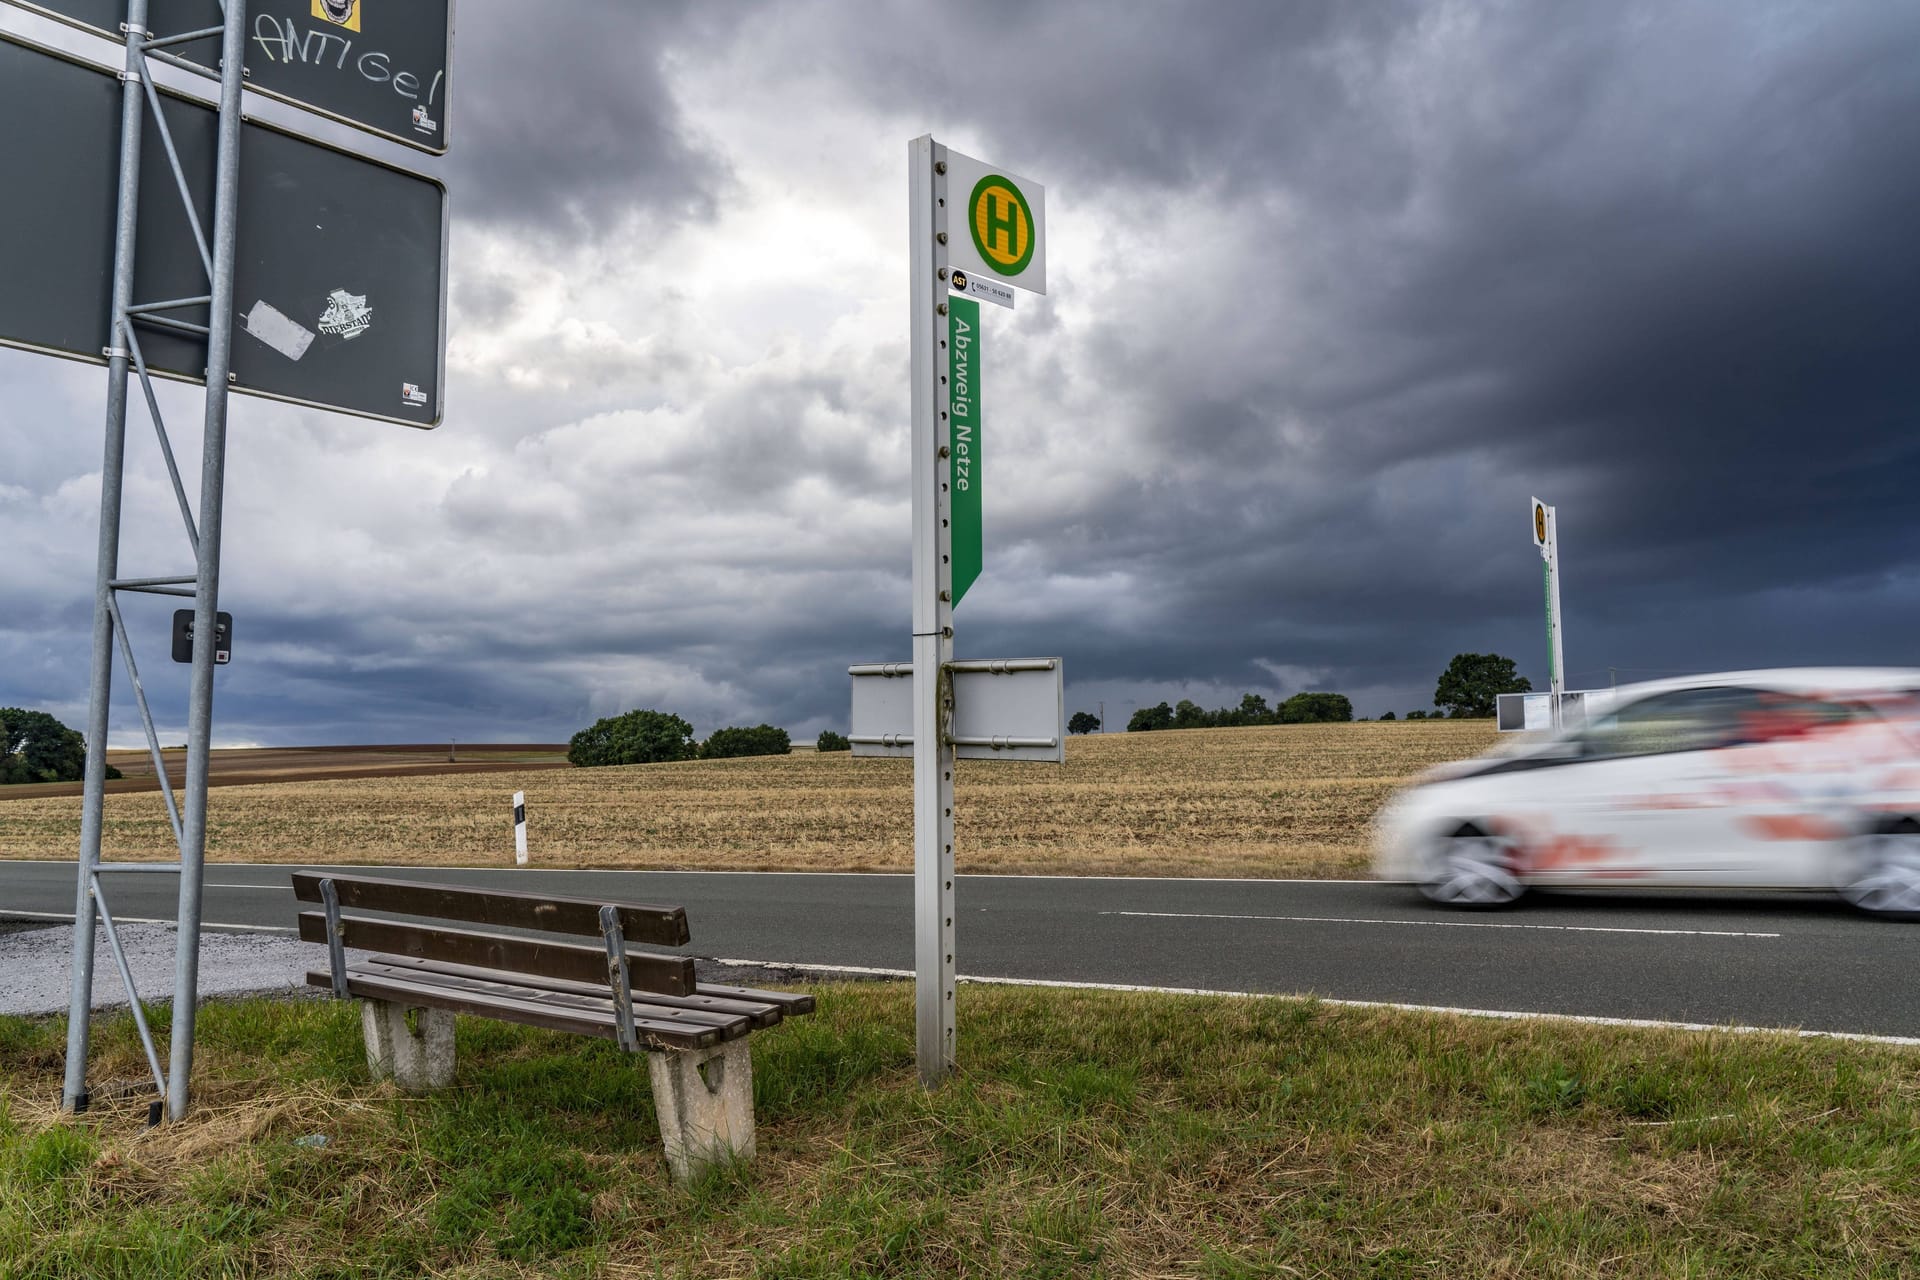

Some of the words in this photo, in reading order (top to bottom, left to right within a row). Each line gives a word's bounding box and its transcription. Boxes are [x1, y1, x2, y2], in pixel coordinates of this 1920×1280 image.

[987, 193, 1018, 257] H
[953, 275, 966, 287] AST
[952, 317, 971, 417] Abzweig
[956, 424, 972, 491] Netze
